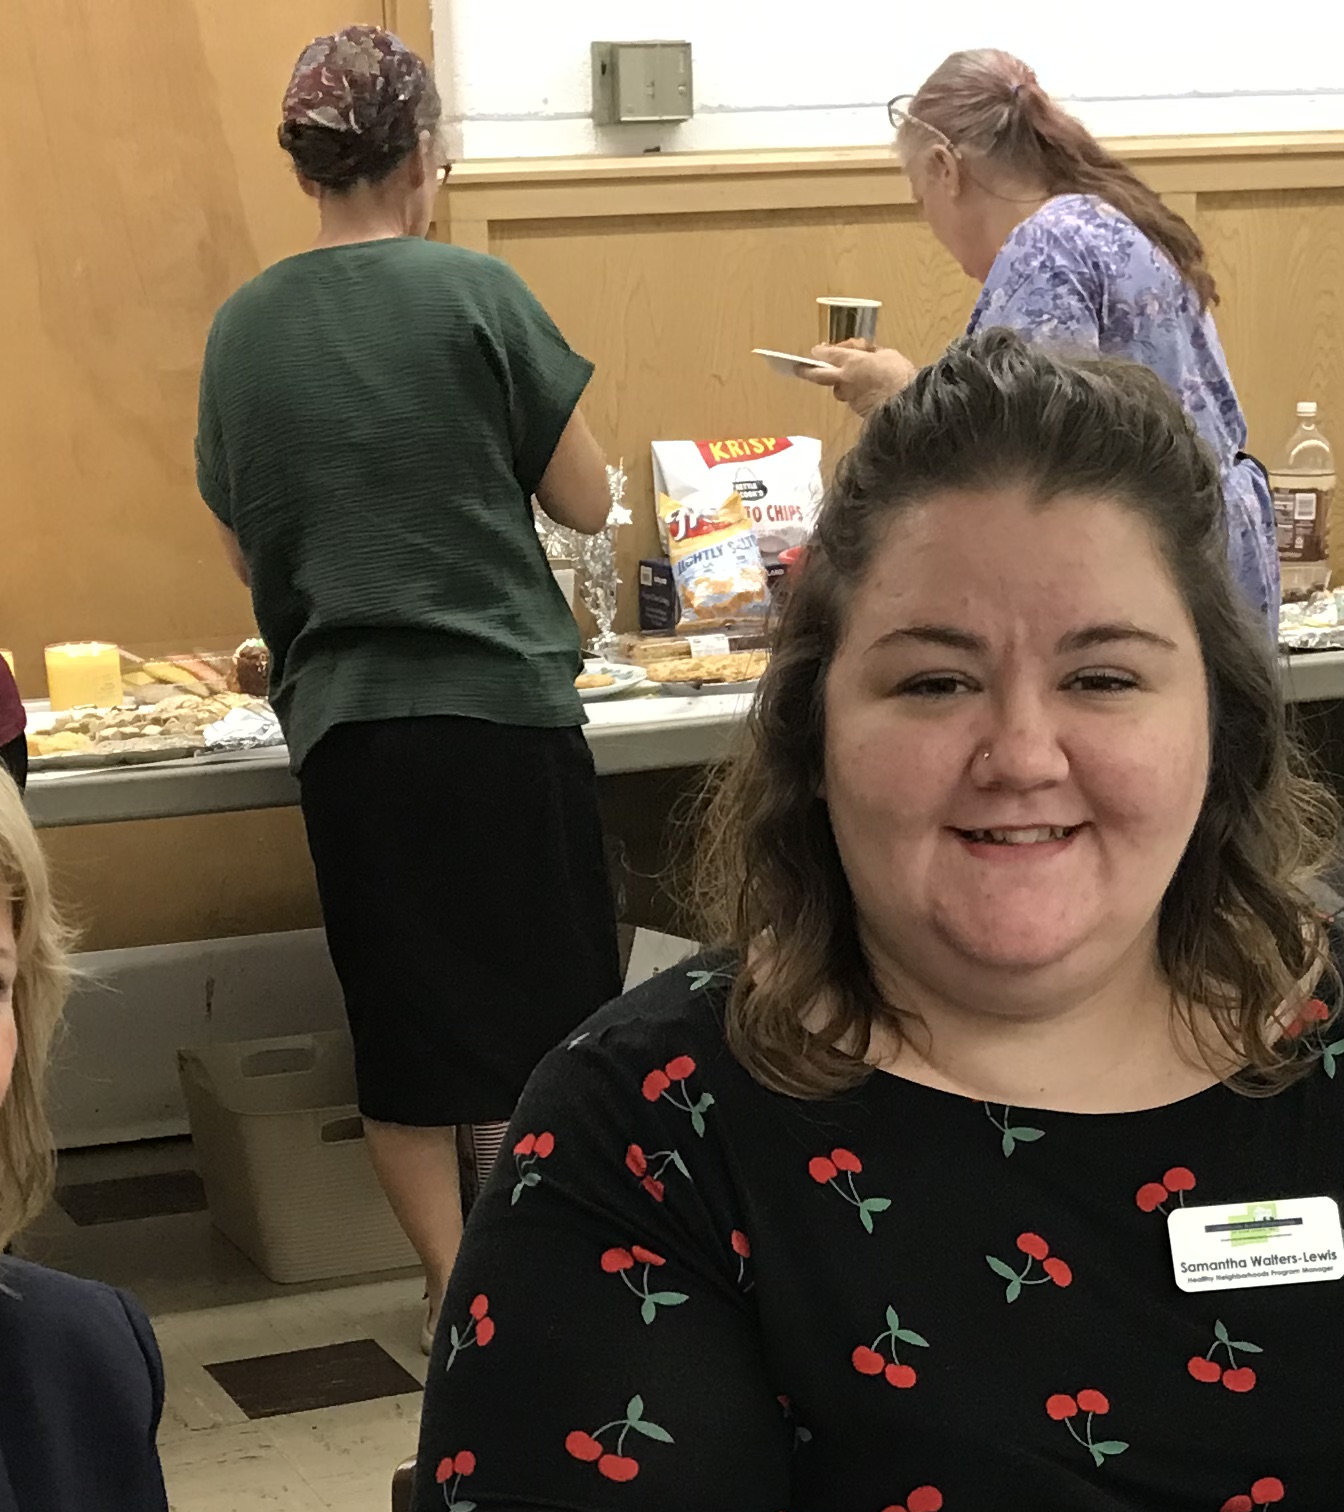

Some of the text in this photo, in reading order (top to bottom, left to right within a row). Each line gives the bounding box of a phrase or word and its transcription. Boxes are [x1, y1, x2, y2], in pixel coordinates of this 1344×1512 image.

[1181, 1249, 1337, 1273] Samantha Walters-Lewis
[1216, 1270, 1269, 1281] Neighborhoods
[1302, 1266, 1333, 1274] Manager
